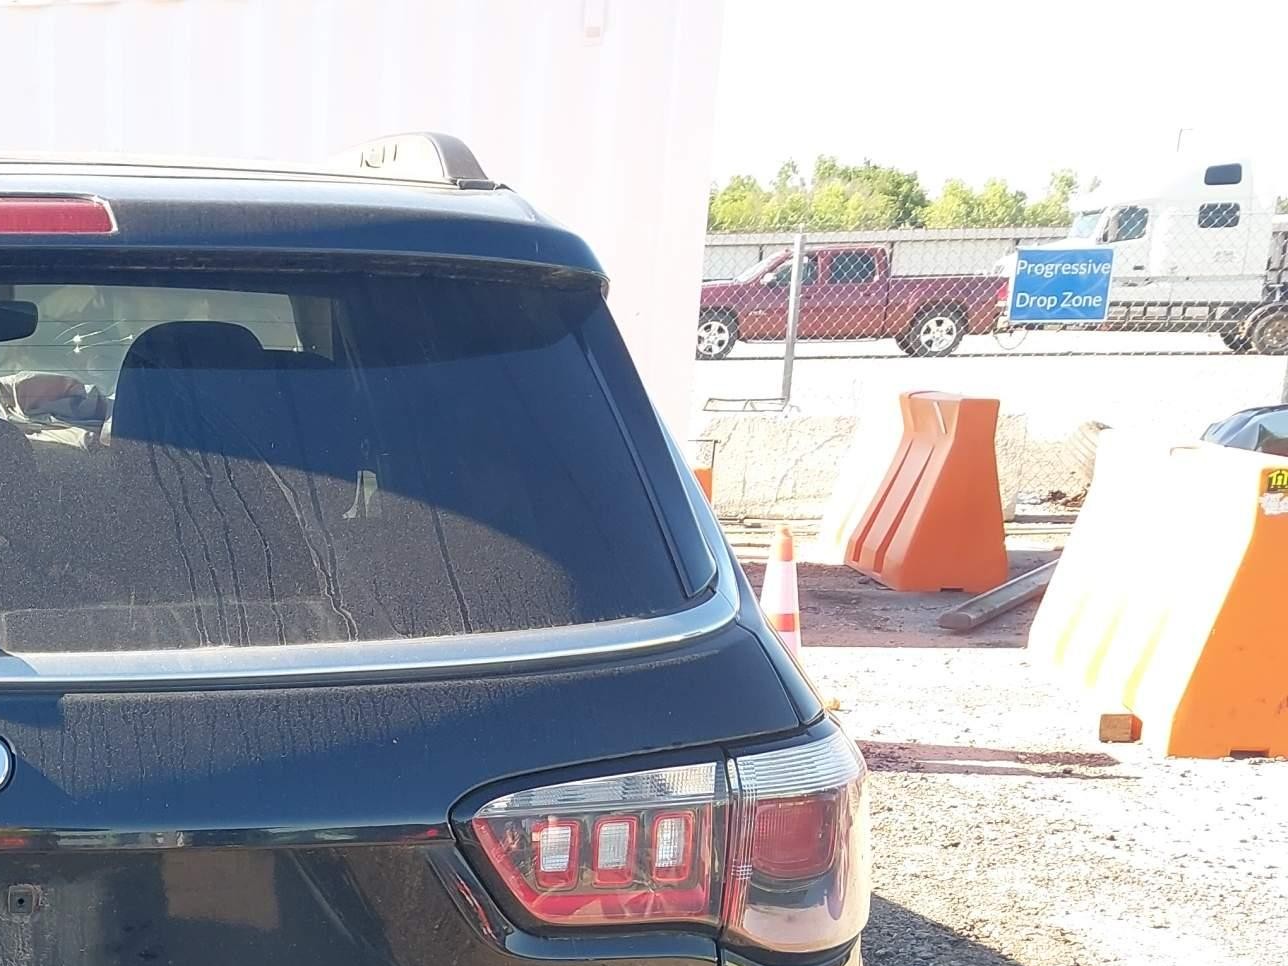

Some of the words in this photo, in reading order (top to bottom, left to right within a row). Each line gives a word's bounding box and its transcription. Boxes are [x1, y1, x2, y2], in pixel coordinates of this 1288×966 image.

[1016, 259, 1112, 278] Progressive
[1015, 292, 1058, 310] Drop
[1060, 291, 1103, 308] Zone
